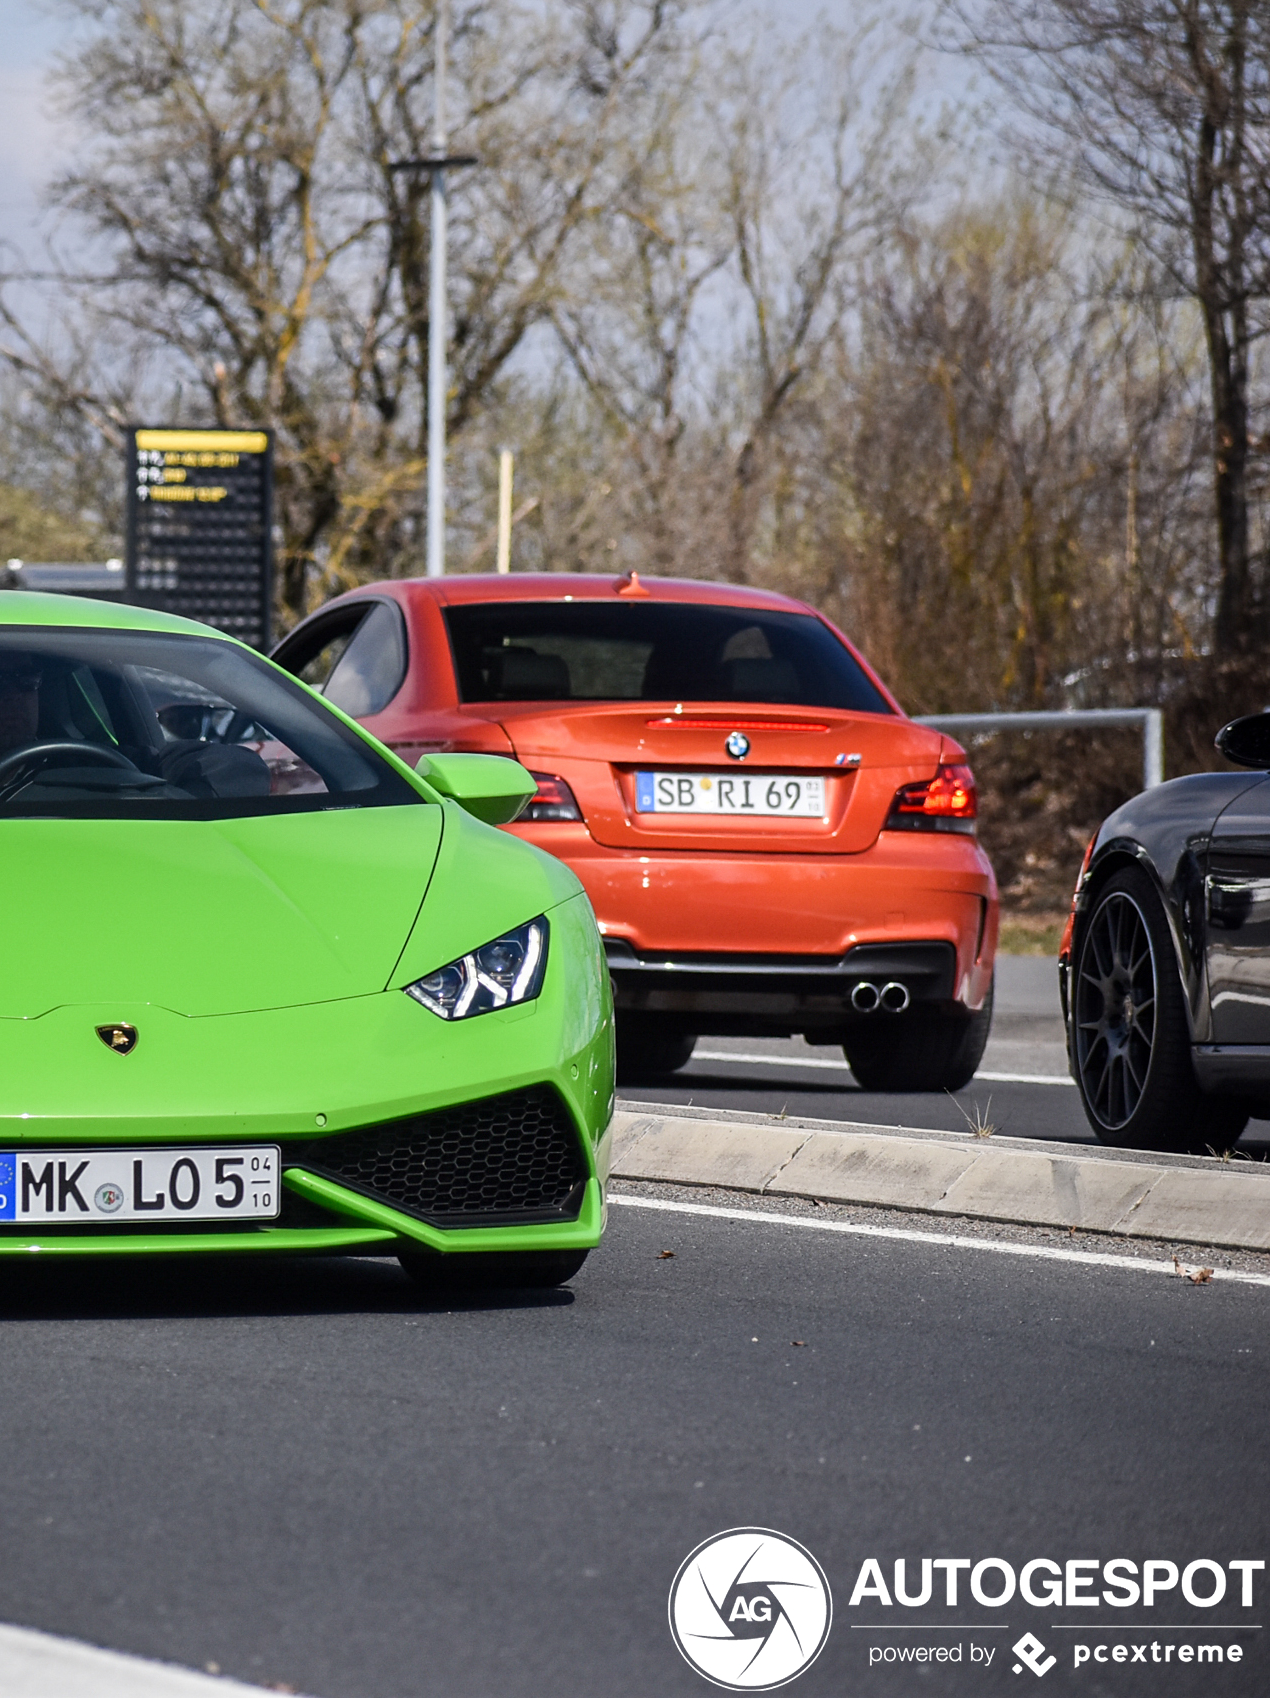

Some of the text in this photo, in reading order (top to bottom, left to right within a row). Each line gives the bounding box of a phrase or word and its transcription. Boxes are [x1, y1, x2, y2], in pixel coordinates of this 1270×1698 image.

[657, 777, 802, 811] SB RI 69
[250, 1156, 272, 1172] 04
[21, 1160, 91, 1213] MK
[132, 1157, 201, 1212] LO
[214, 1156, 245, 1210] 5
[251, 1192, 272, 1208] 10
